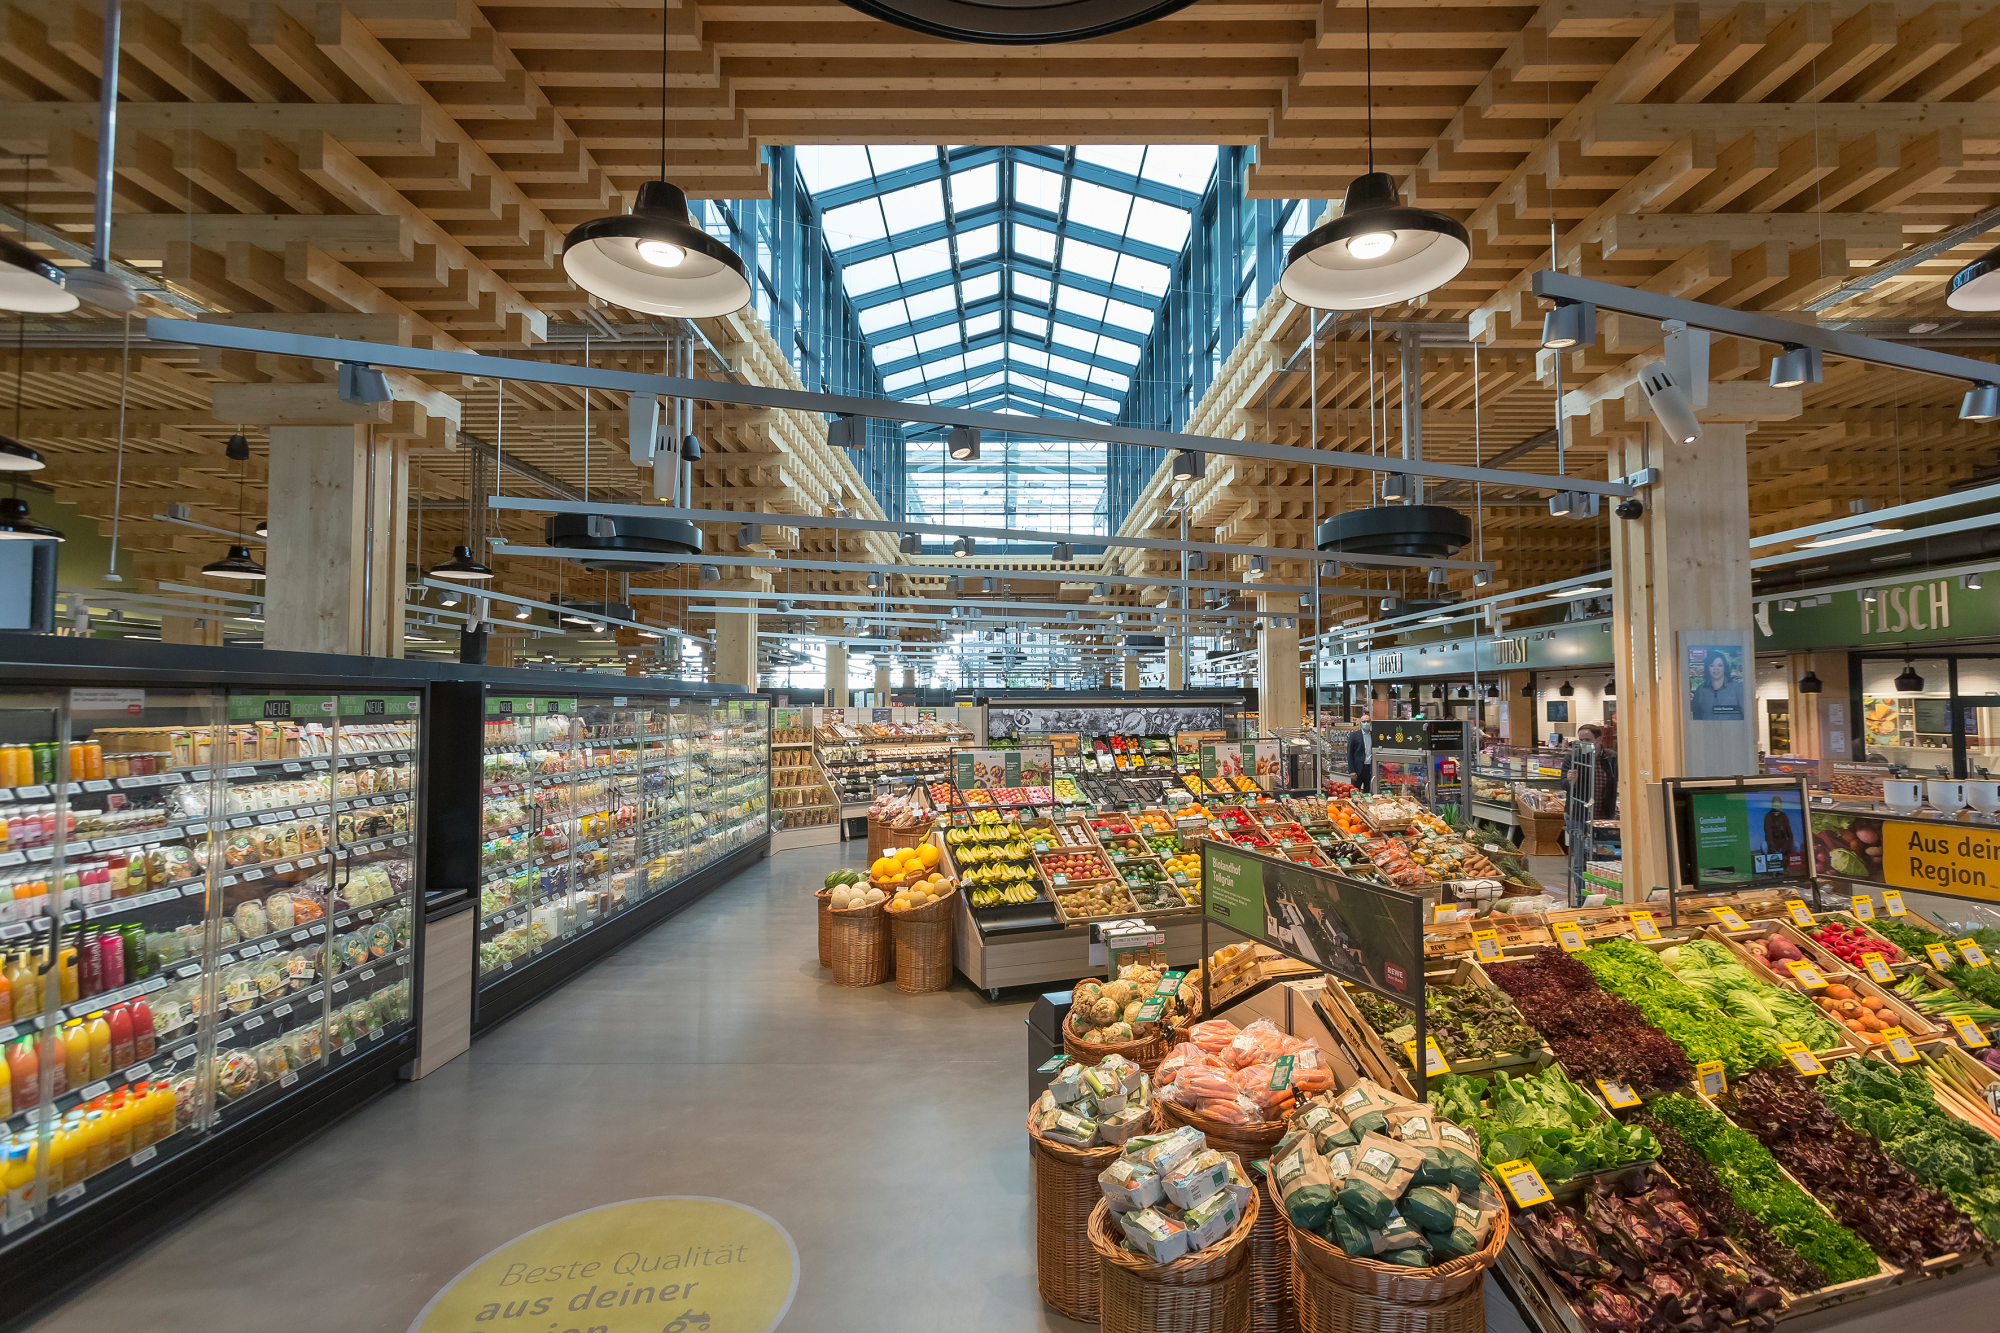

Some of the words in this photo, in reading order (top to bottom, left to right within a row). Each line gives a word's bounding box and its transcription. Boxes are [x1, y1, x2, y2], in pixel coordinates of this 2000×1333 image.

[1861, 581, 1949, 634] FISCH
[266, 703, 289, 715] NEUE
[366, 702, 384, 713] NEUE
[500, 702, 512, 711] NEUE
[1388, 773, 1418, 786] REWE
[1908, 831, 1949, 854] Aus
[1212, 857, 1241, 875] Biolandhof
[1910, 857, 1985, 887] Region
[1387, 967, 1403, 978] REWE
[1343, 1100, 1371, 1114] Bioland
[1281, 1167, 1304, 1185] Bioland
[1359, 1163, 1388, 1183] Bioland
[500, 1263, 601, 1287] Beste
[613, 1244, 749, 1277] Qualität
[475, 1296, 554, 1322] aus
[567, 1281, 700, 1313] deiner
